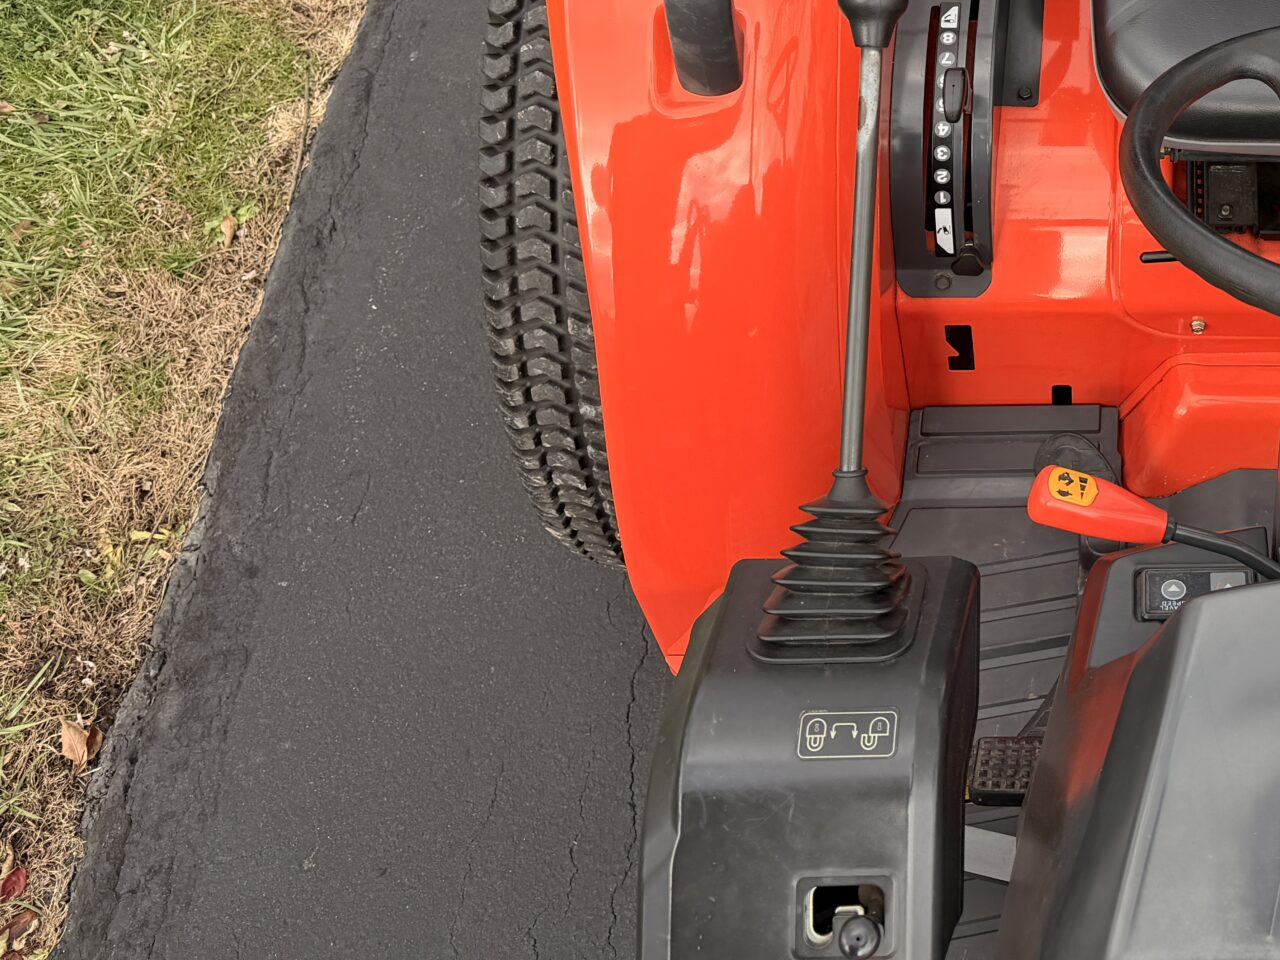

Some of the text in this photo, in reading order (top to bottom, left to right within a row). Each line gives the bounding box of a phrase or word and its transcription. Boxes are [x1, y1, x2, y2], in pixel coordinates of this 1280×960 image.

[944, 33, 953, 43] 8
[942, 53, 951, 64] 7
[938, 124, 949, 135] 4
[937, 148, 947, 159] 3
[937, 172, 947, 182] 2
[939, 193, 947, 202] 1
